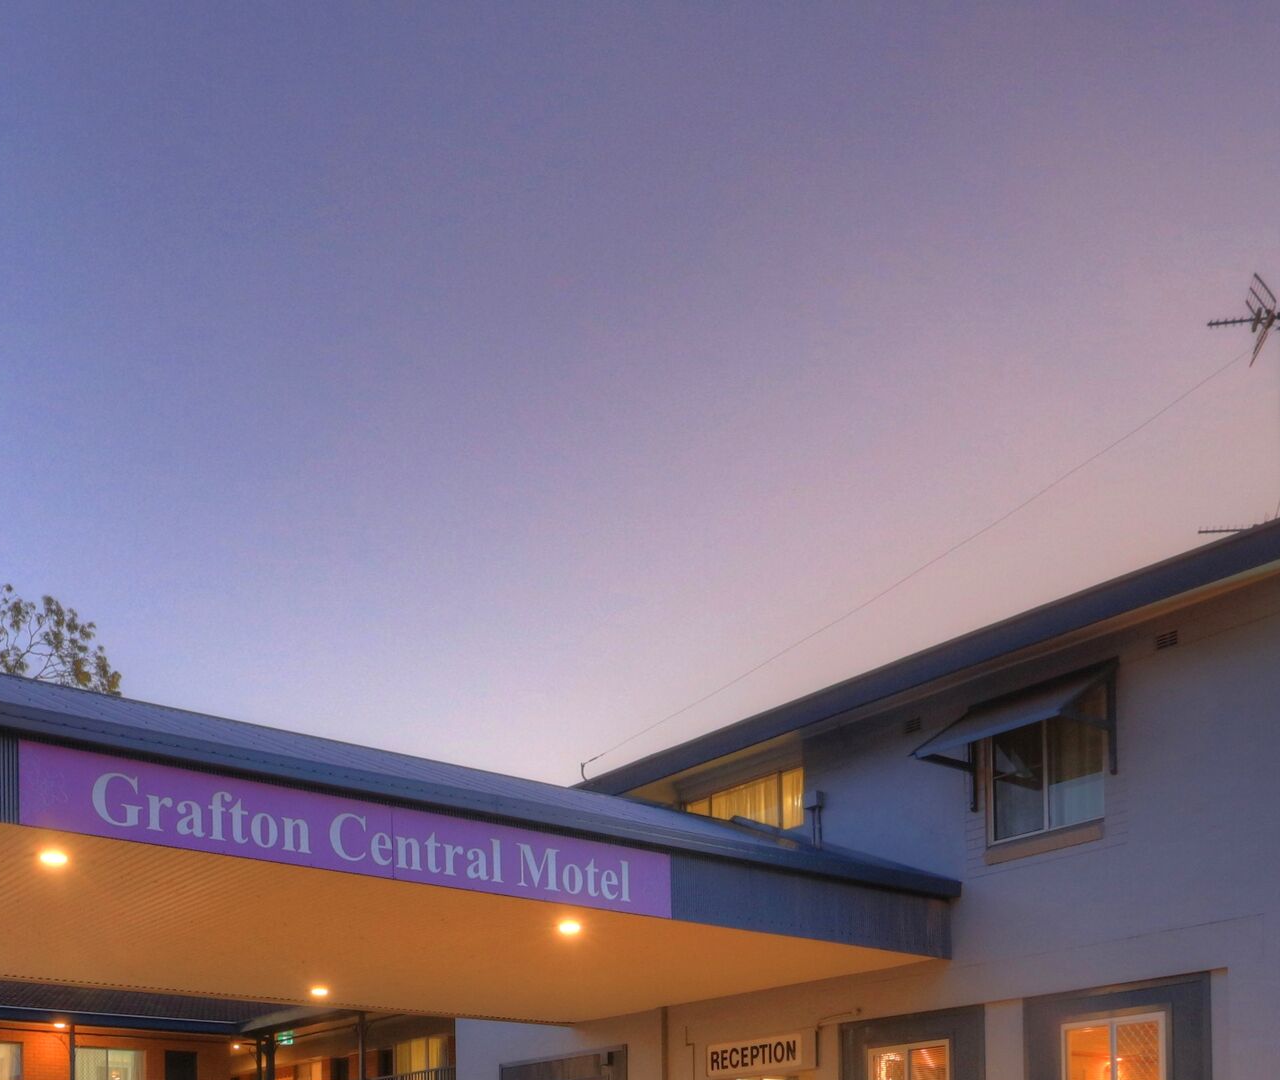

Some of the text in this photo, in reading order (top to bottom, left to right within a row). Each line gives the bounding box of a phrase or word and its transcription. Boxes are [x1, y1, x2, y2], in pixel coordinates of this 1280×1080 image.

[91, 771, 632, 903] Grafton Central Motel
[710, 1039, 796, 1071] RECEPTION
